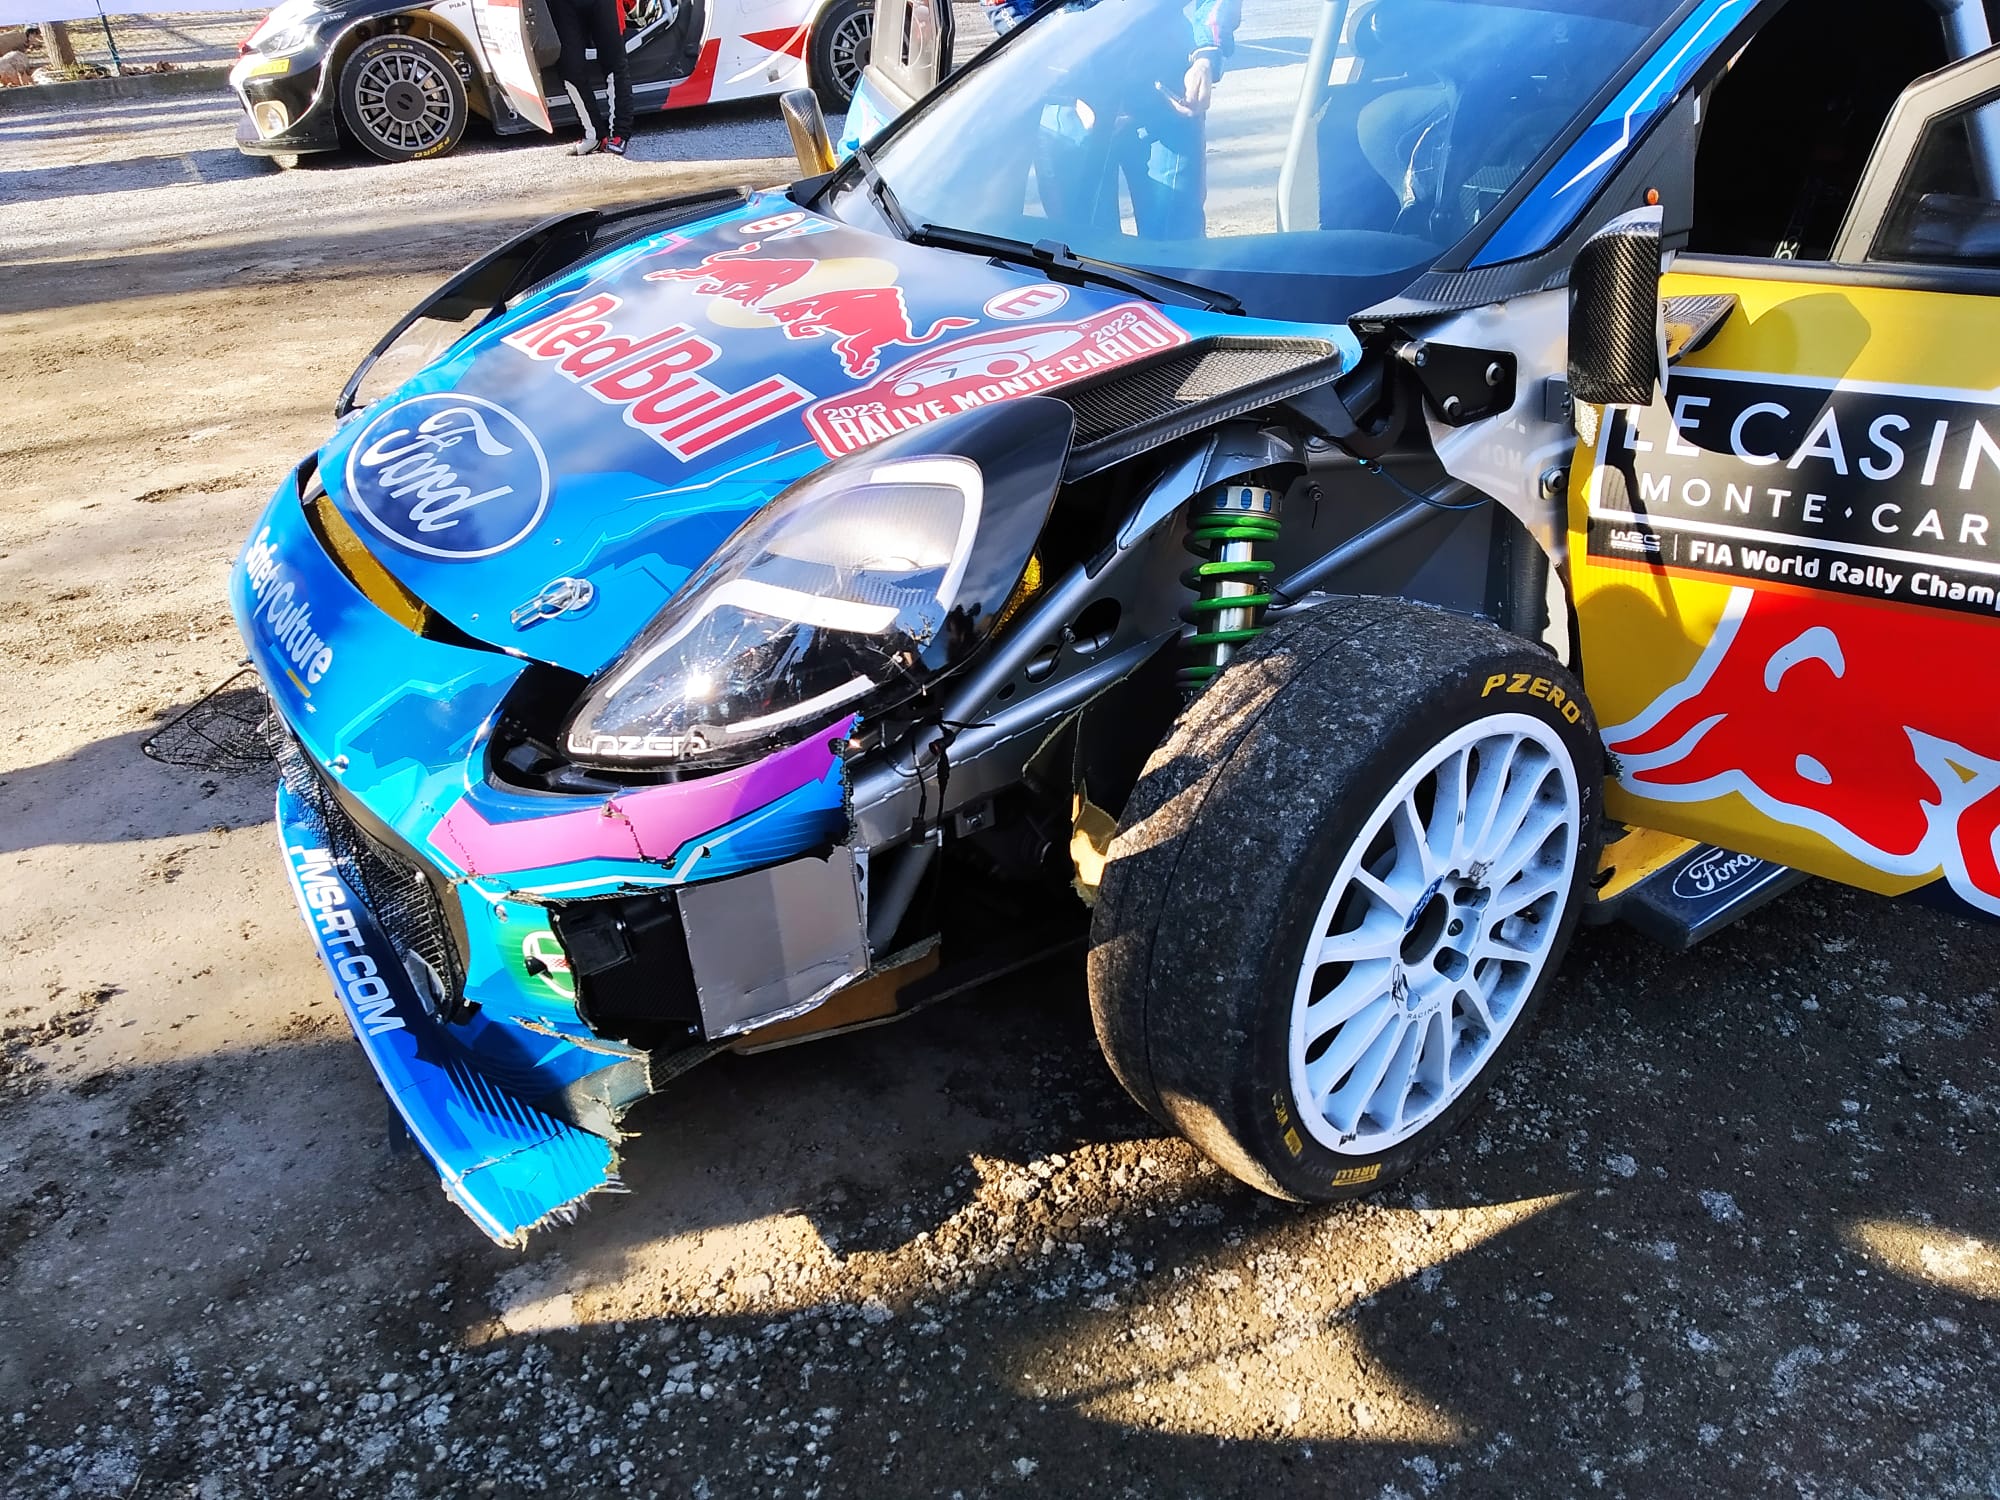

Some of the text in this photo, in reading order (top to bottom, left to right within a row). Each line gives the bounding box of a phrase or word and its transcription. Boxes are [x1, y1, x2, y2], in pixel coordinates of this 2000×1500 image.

[1089, 311, 1138, 344] 2023
[822, 401, 887, 421] 2023
[829, 399, 951, 450] RALLYE
[1622, 394, 1712, 458] LE
[360, 407, 514, 532] Ford
[1640, 472, 1990, 546] MONTE CAR
[1610, 528, 1661, 547] WRC
[1689, 539, 1734, 567] FIA
[1741, 546, 1820, 578] World
[1829, 561, 1902, 594] Rally
[1332, 1163, 1382, 1187] PIRELLI
